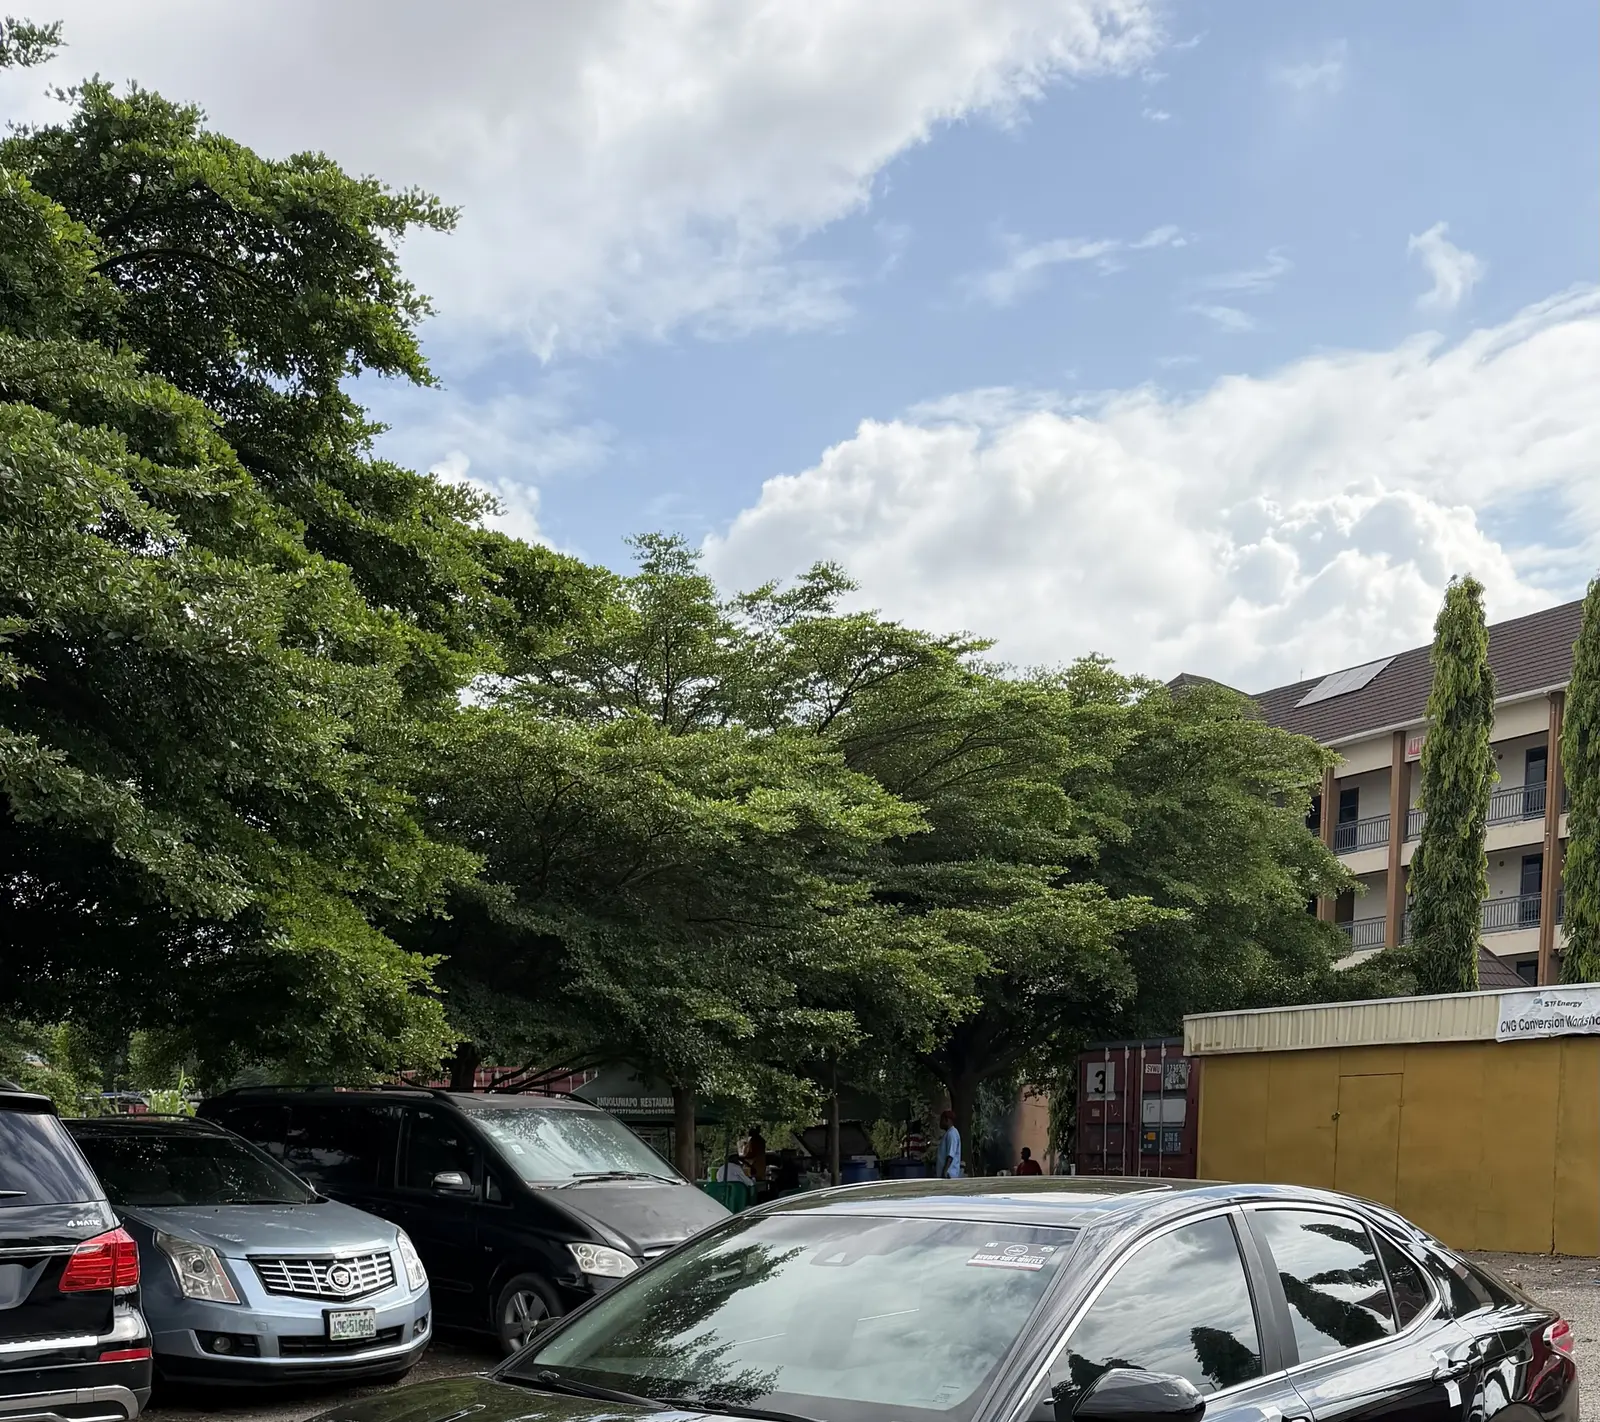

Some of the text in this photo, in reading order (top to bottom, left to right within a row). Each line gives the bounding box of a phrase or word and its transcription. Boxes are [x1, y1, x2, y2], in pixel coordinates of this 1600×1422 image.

[1557, 1000, 1582, 1008] Energy
[1500, 1019, 1517, 1033] CNG
[1518, 1016, 1565, 1031] Conversion
[1094, 1070, 1107, 1093] 3
